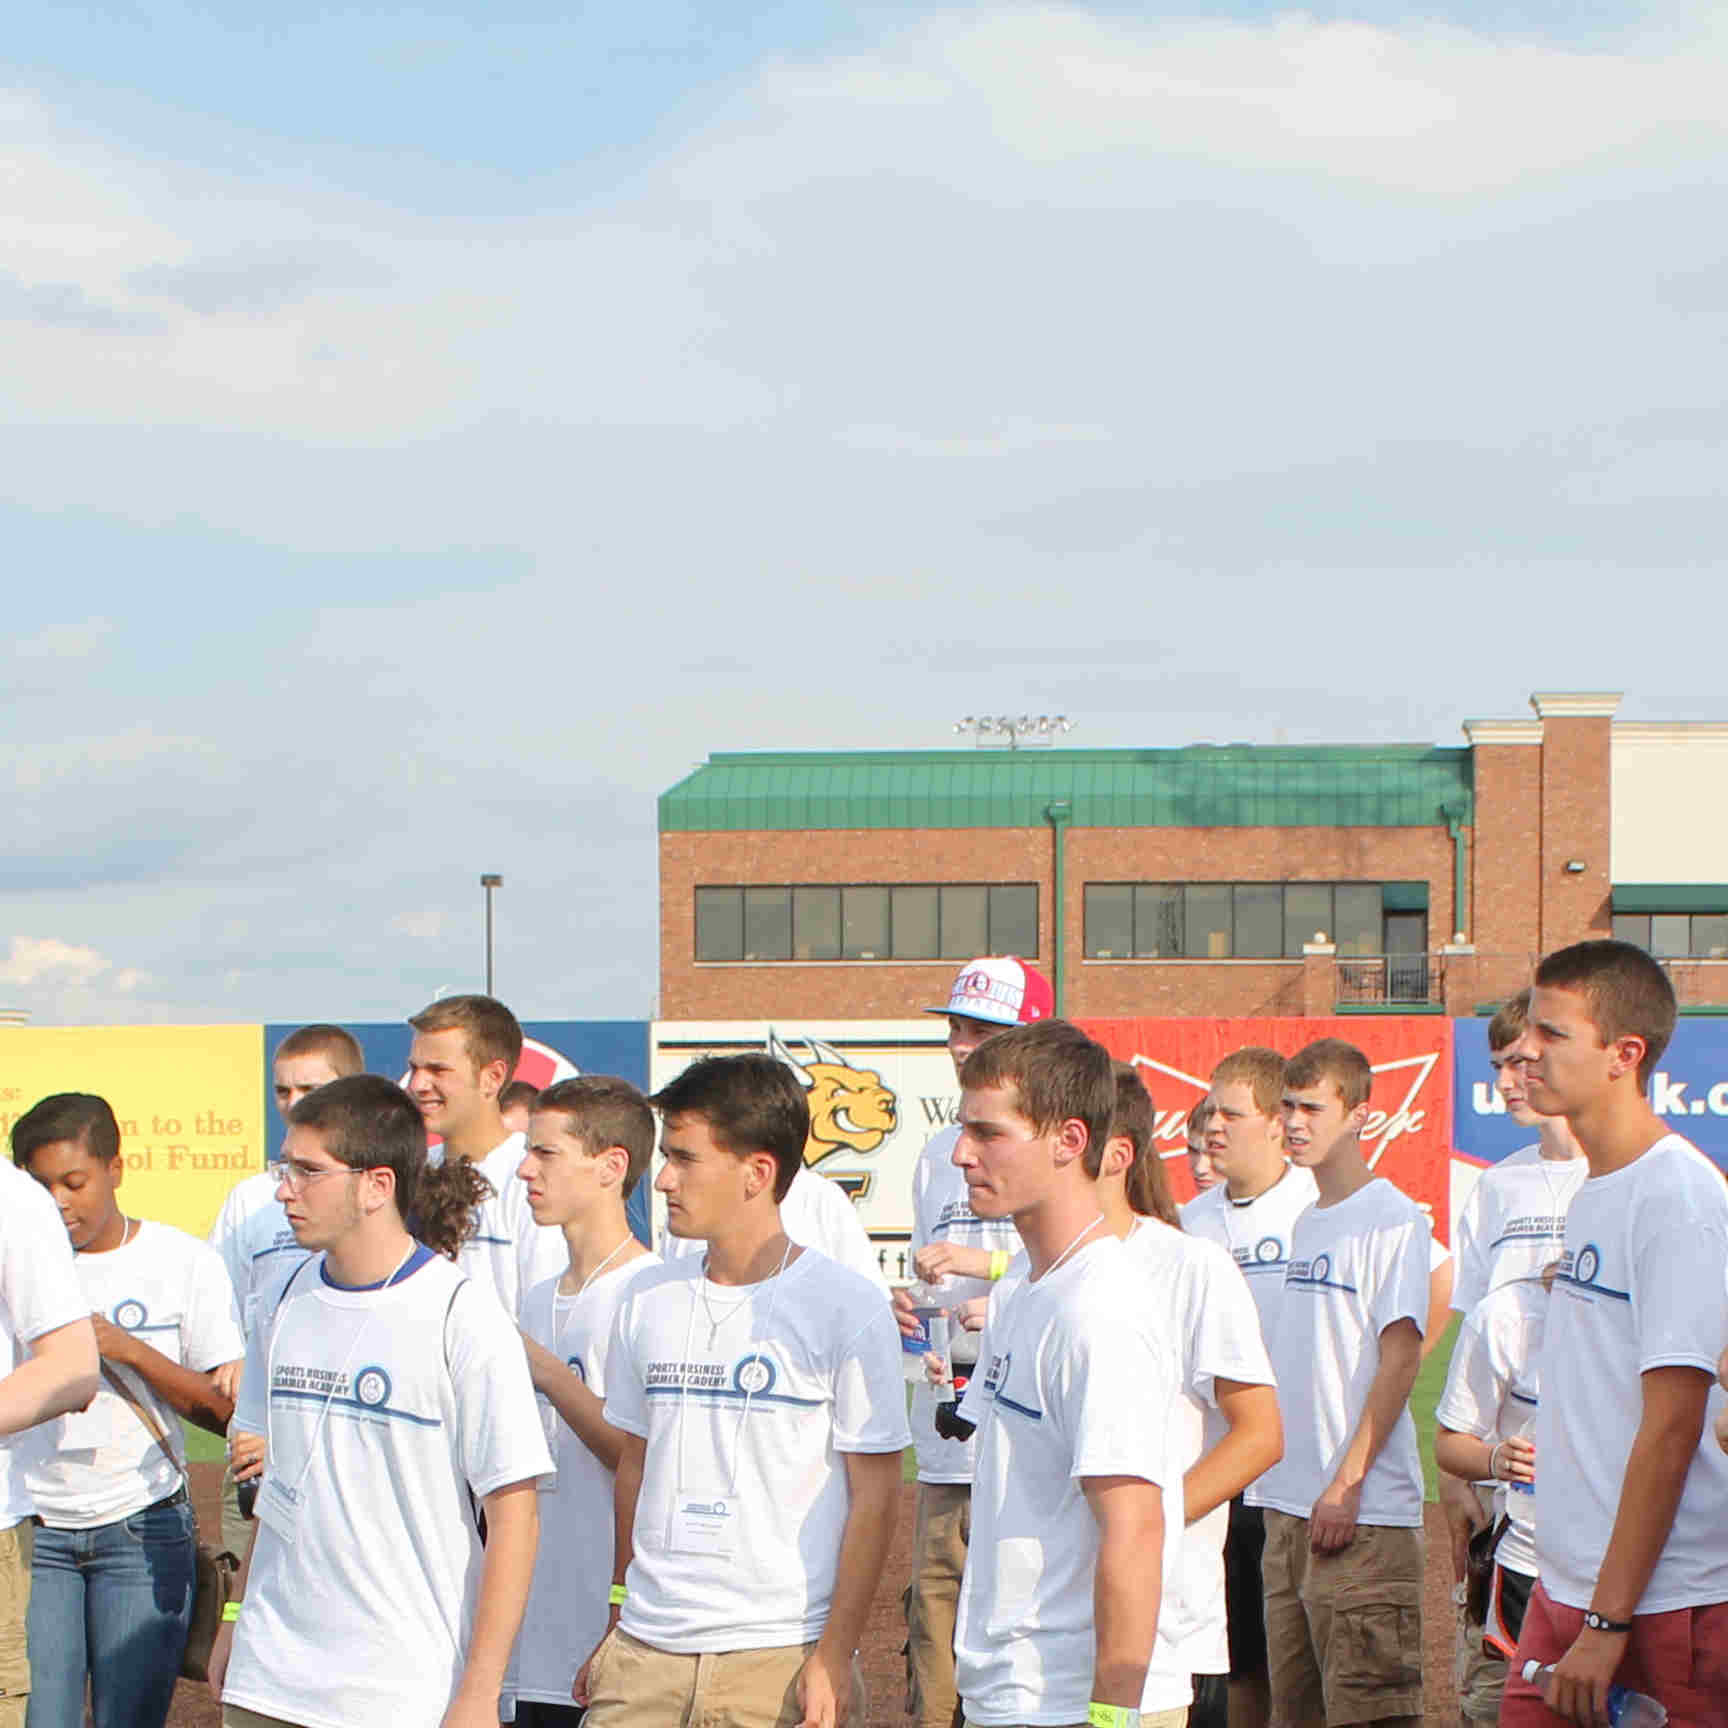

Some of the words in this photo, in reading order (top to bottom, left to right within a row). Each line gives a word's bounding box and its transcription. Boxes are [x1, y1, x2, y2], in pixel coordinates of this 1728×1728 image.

[151, 1114, 183, 1137] to
[193, 1103, 244, 1137] the
[166, 1144, 257, 1171] Fund.
